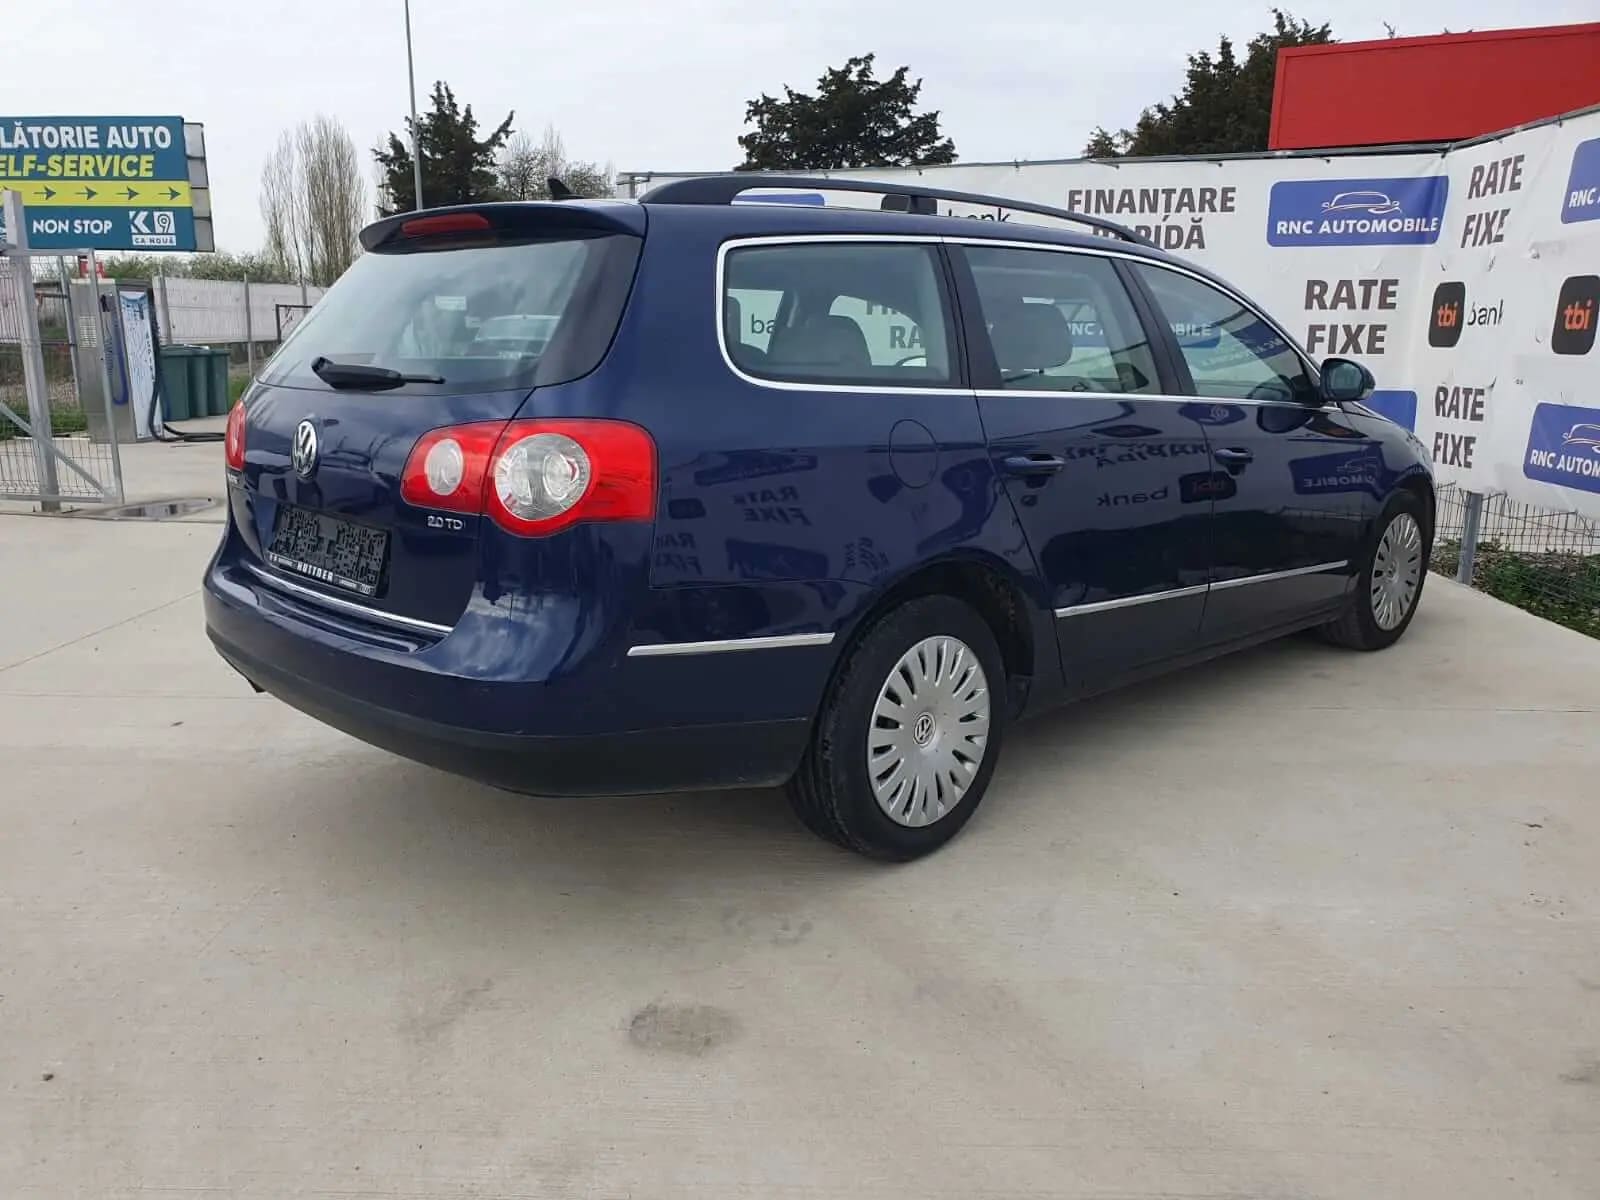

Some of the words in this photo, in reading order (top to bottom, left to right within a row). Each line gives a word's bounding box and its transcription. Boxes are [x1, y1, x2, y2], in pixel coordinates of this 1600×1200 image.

[0, 120, 99, 149] LĂTORIE
[107, 126, 171, 149] AUTO
[1468, 154, 1525, 200] RATE
[1569, 187, 1597, 208] RNC
[33, 219, 69, 234] NON
[73, 219, 112, 234] STOP
[1276, 221, 1314, 234] RNC
[1318, 217, 1440, 234] AUTOMOBILE
[1460, 208, 1511, 249] FIXE
[1304, 279, 1400, 311] RATE
[1437, 301, 1458, 327] tbi
[1564, 299, 1592, 331] tbi
[1307, 324, 1388, 355] FIXE
[1435, 385, 1485, 421] RATE
[1432, 431, 1477, 469] FIXE
[1530, 449, 1556, 469] RNC
